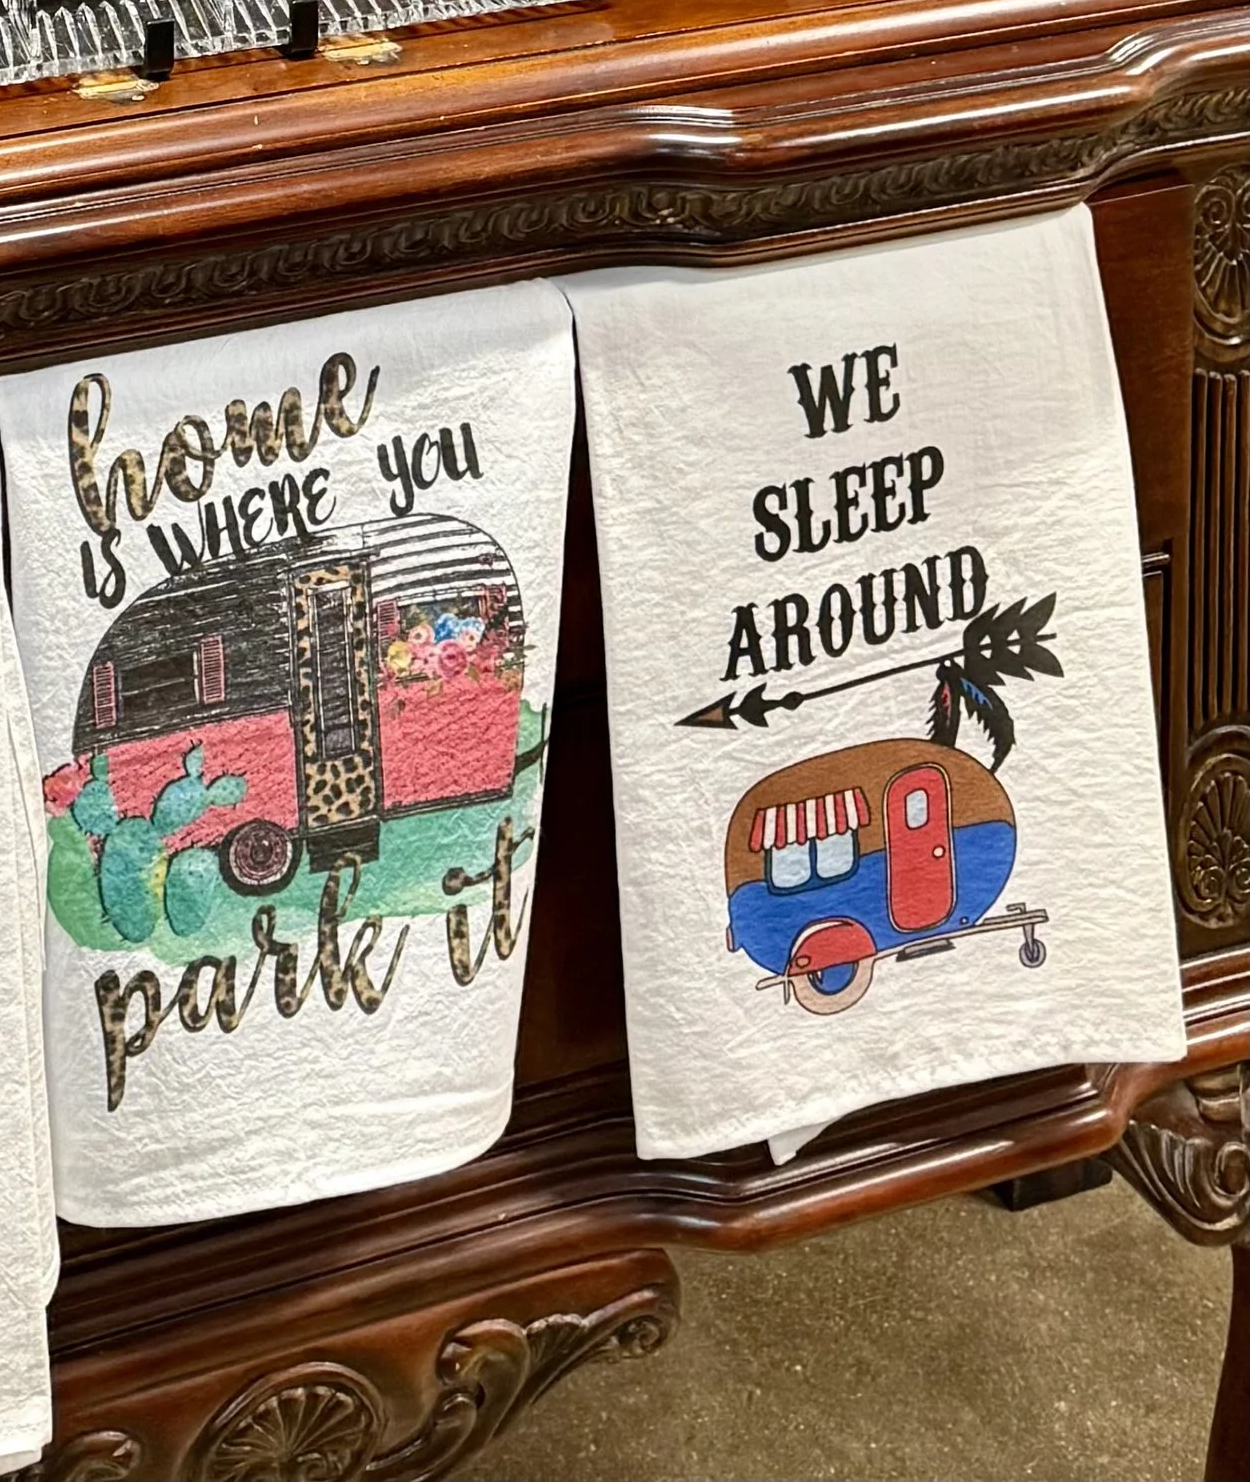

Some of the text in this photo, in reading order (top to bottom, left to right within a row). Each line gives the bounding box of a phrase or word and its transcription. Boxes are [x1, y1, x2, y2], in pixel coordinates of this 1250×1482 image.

[70, 352, 380, 534] home
[787, 344, 901, 439] WE
[150, 466, 336, 577] WHERE
[752, 445, 945, 563] SLEEP
[721, 544, 989, 682] AROUND
[95, 816, 535, 1113] park it
